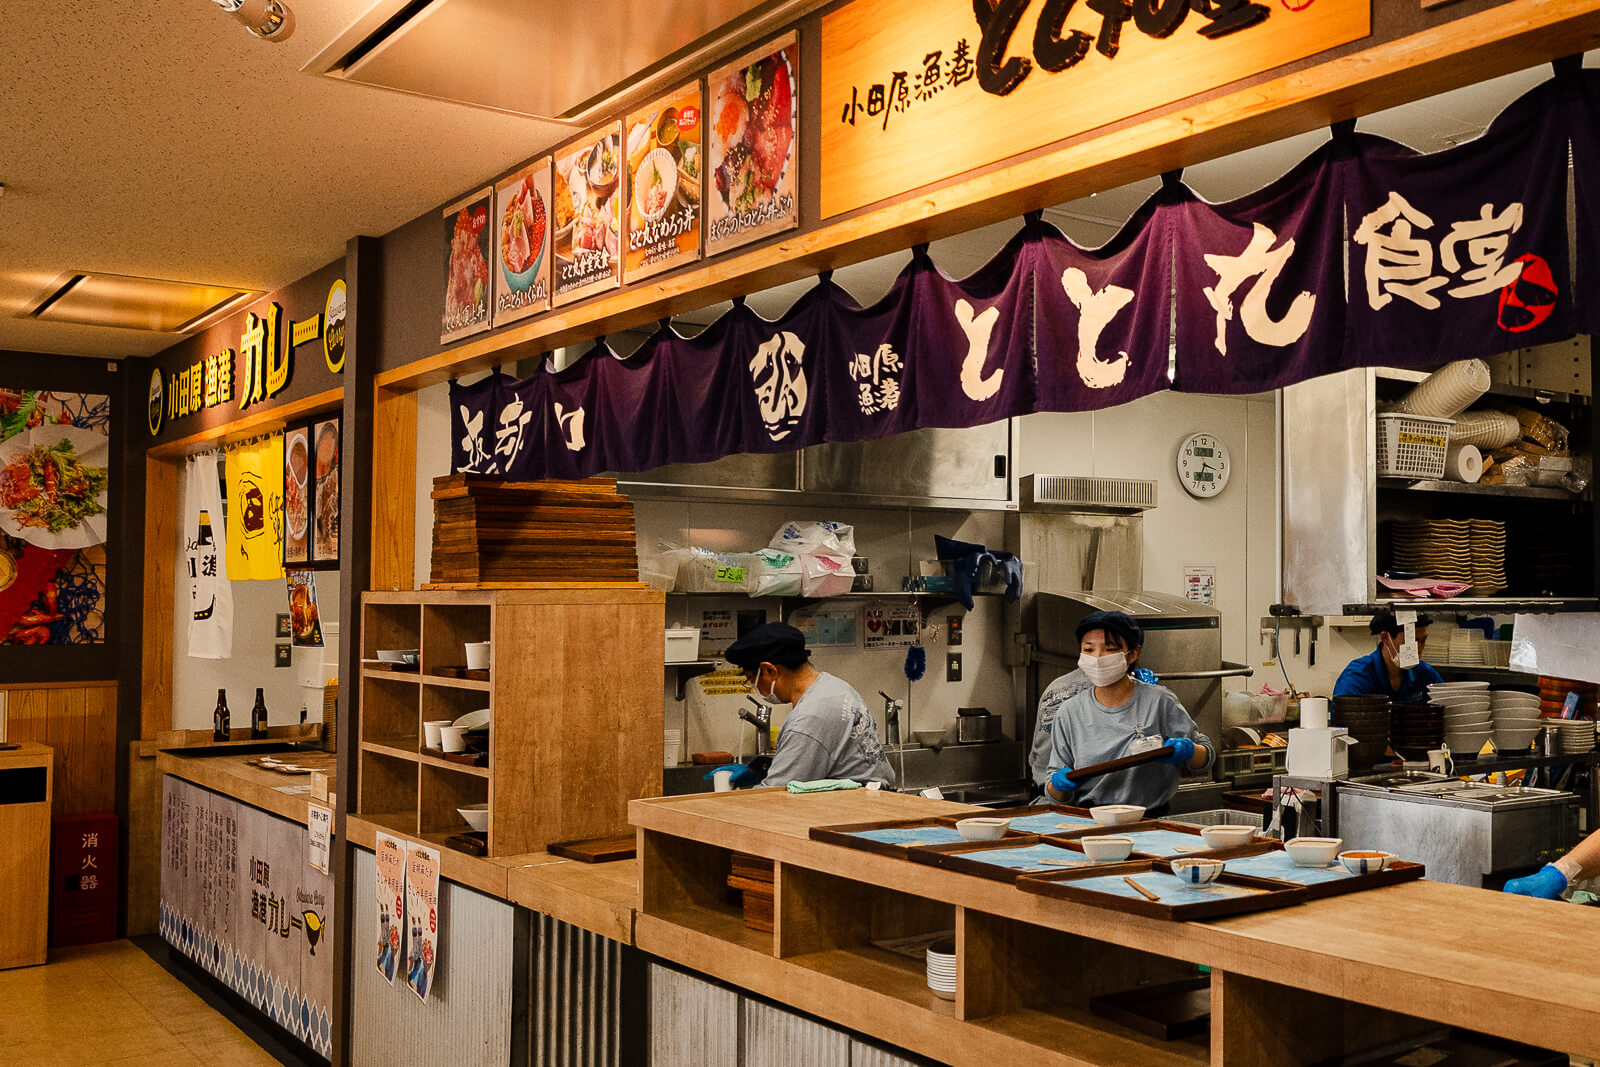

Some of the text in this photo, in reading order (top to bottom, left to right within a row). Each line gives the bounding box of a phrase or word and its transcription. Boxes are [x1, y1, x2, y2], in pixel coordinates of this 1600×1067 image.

[842, 40, 974, 130] 小田原漁港
[168, 302, 319, 420] 小田原漁港 カレー
[1201, 438, 1207, 446] 12
[1185, 448, 1192, 456] 10
[1220, 462, 1225, 470] 3
[1185, 471, 1190, 479] 8
[1217, 473, 1222, 481] 4
[1192, 481, 1197, 489] 7
[1211, 482, 1216, 490] 5
[80, 832, 99, 890] 消火器
[268, 890, 303, 939] カレー
